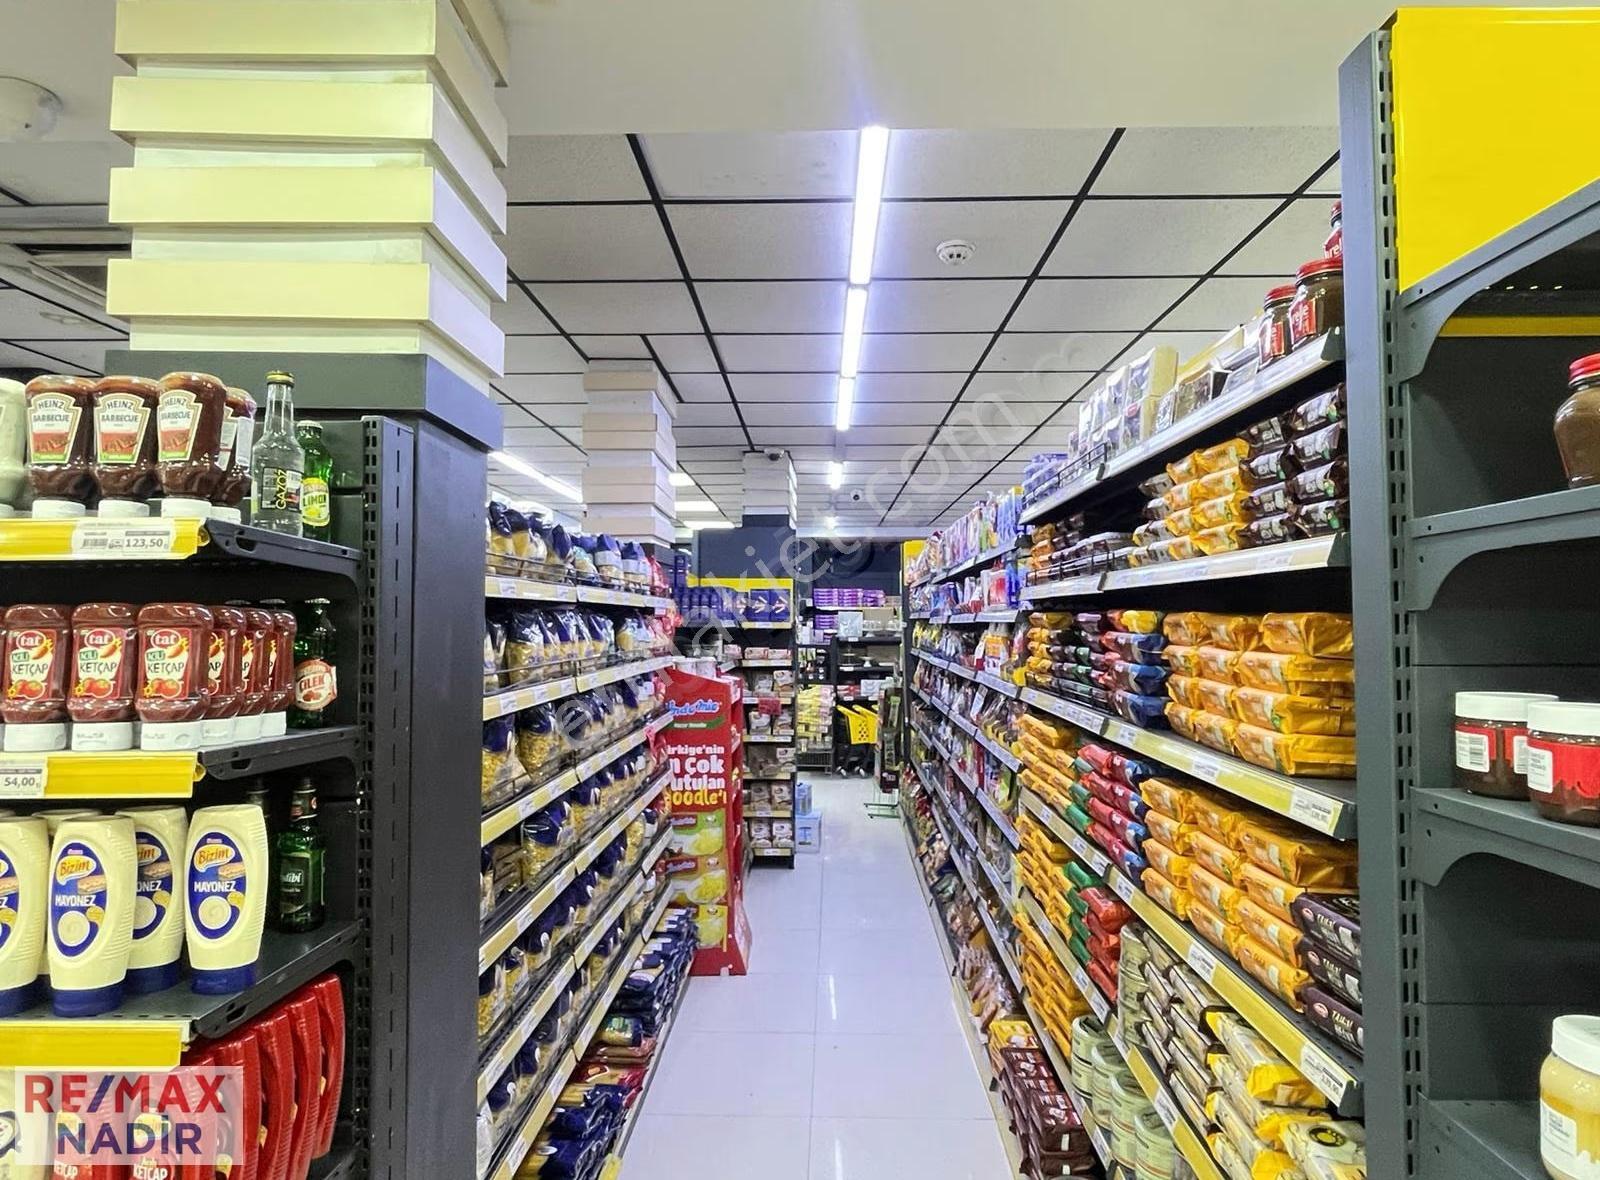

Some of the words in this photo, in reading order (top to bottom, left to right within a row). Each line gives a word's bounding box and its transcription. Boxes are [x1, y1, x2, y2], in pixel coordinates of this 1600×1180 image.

[38, 400, 64, 409] HEINZ
[107, 401, 133, 410] HEINZ
[276, 469, 287, 509] GAZOZ
[21, 636, 41, 646] tat
[88, 635, 109, 645] tat
[155, 635, 177, 645] tat
[13, 663, 48, 676] KETÇAP
[80, 662, 116, 675] KETÇAP
[148, 661, 184, 674] KETÇAP
[685, 754, 725, 775] Çok
[5, 777, 35, 788] 54,00
[671, 773, 725, 791] utulan
[198, 848, 228, 865] Bizim
[60, 860, 89, 876] Bizim
[194, 881, 236, 892] MAYONEZ
[55, 895, 96, 906] MAYONEZ
